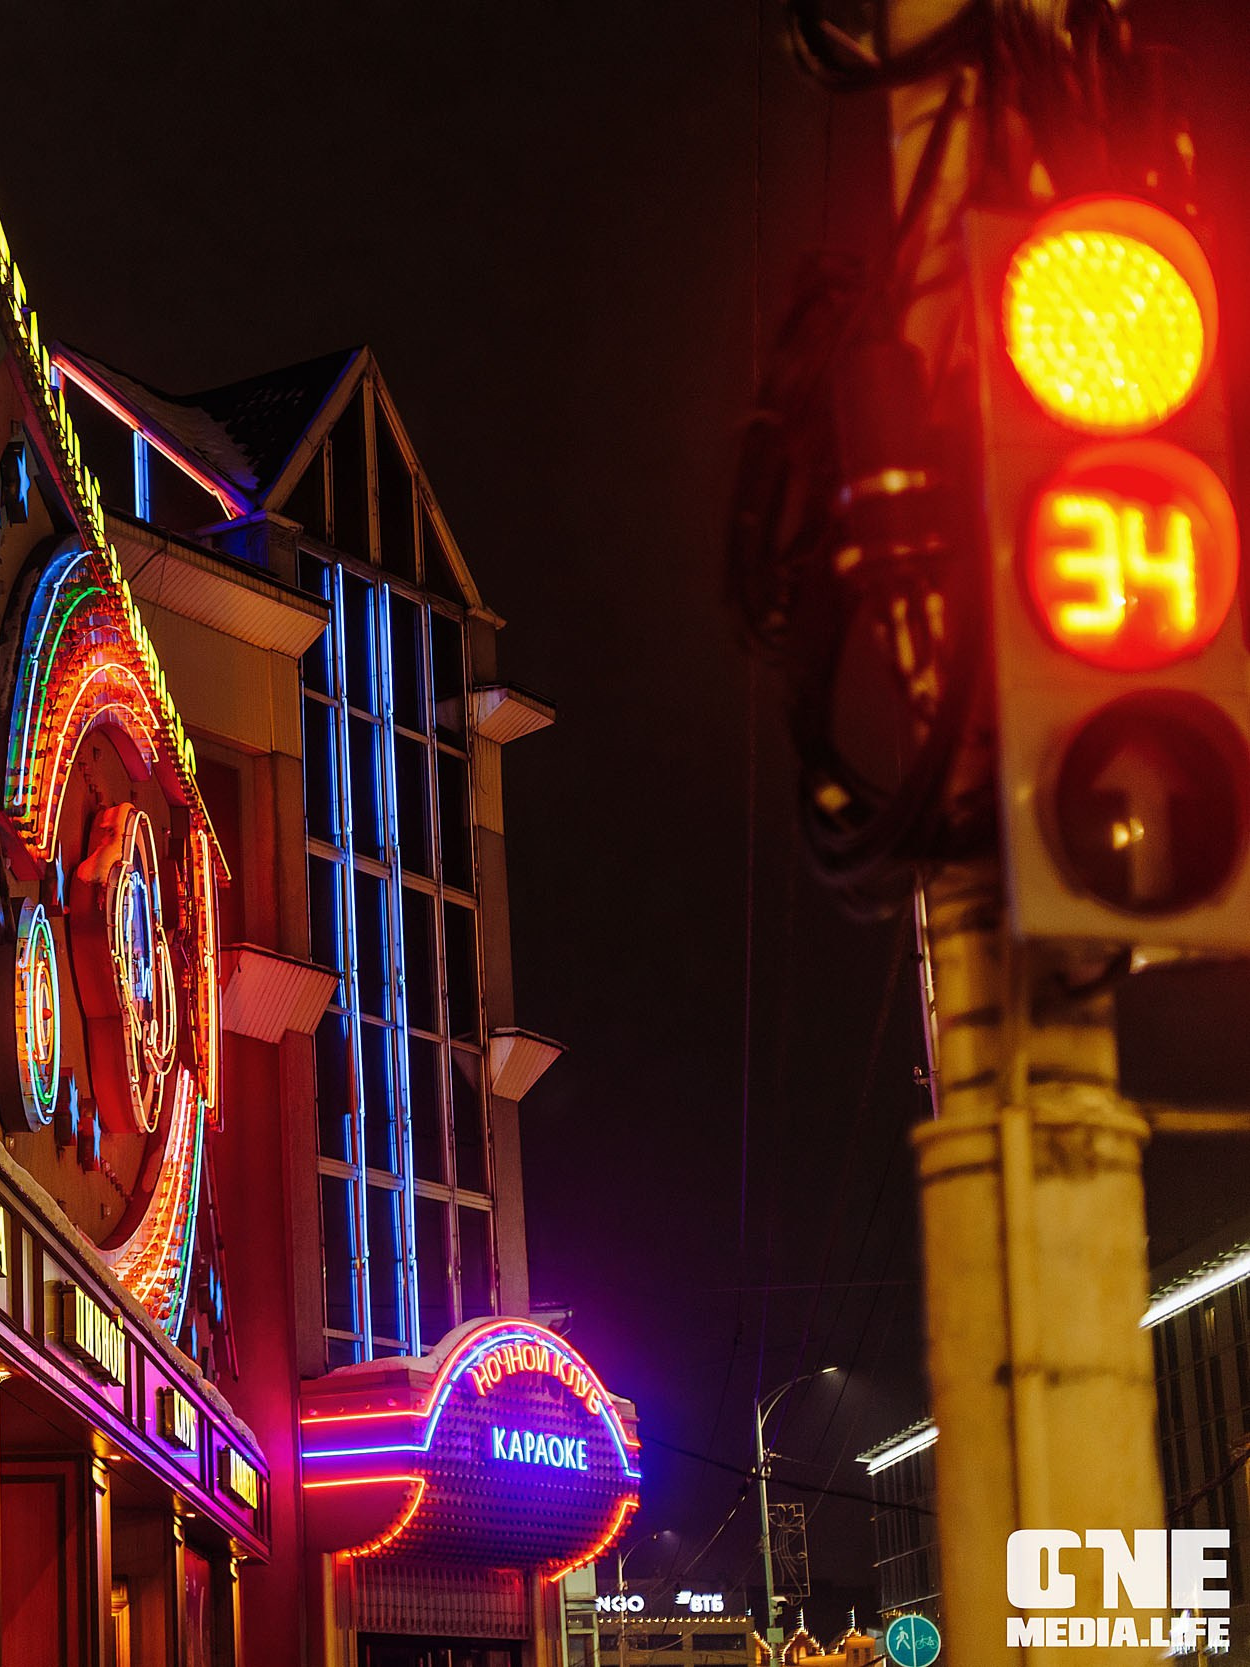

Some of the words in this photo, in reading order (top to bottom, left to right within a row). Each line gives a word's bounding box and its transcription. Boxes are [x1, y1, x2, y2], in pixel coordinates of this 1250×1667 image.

[1053, 492, 1197, 637] 34
[75, 1285, 126, 1387] ПИВНОЙ
[553, 1352, 602, 1416] КЛУБ
[491, 1426, 589, 1471] КАРАОКЕ
[690, 1594, 725, 1613] ВТБ
